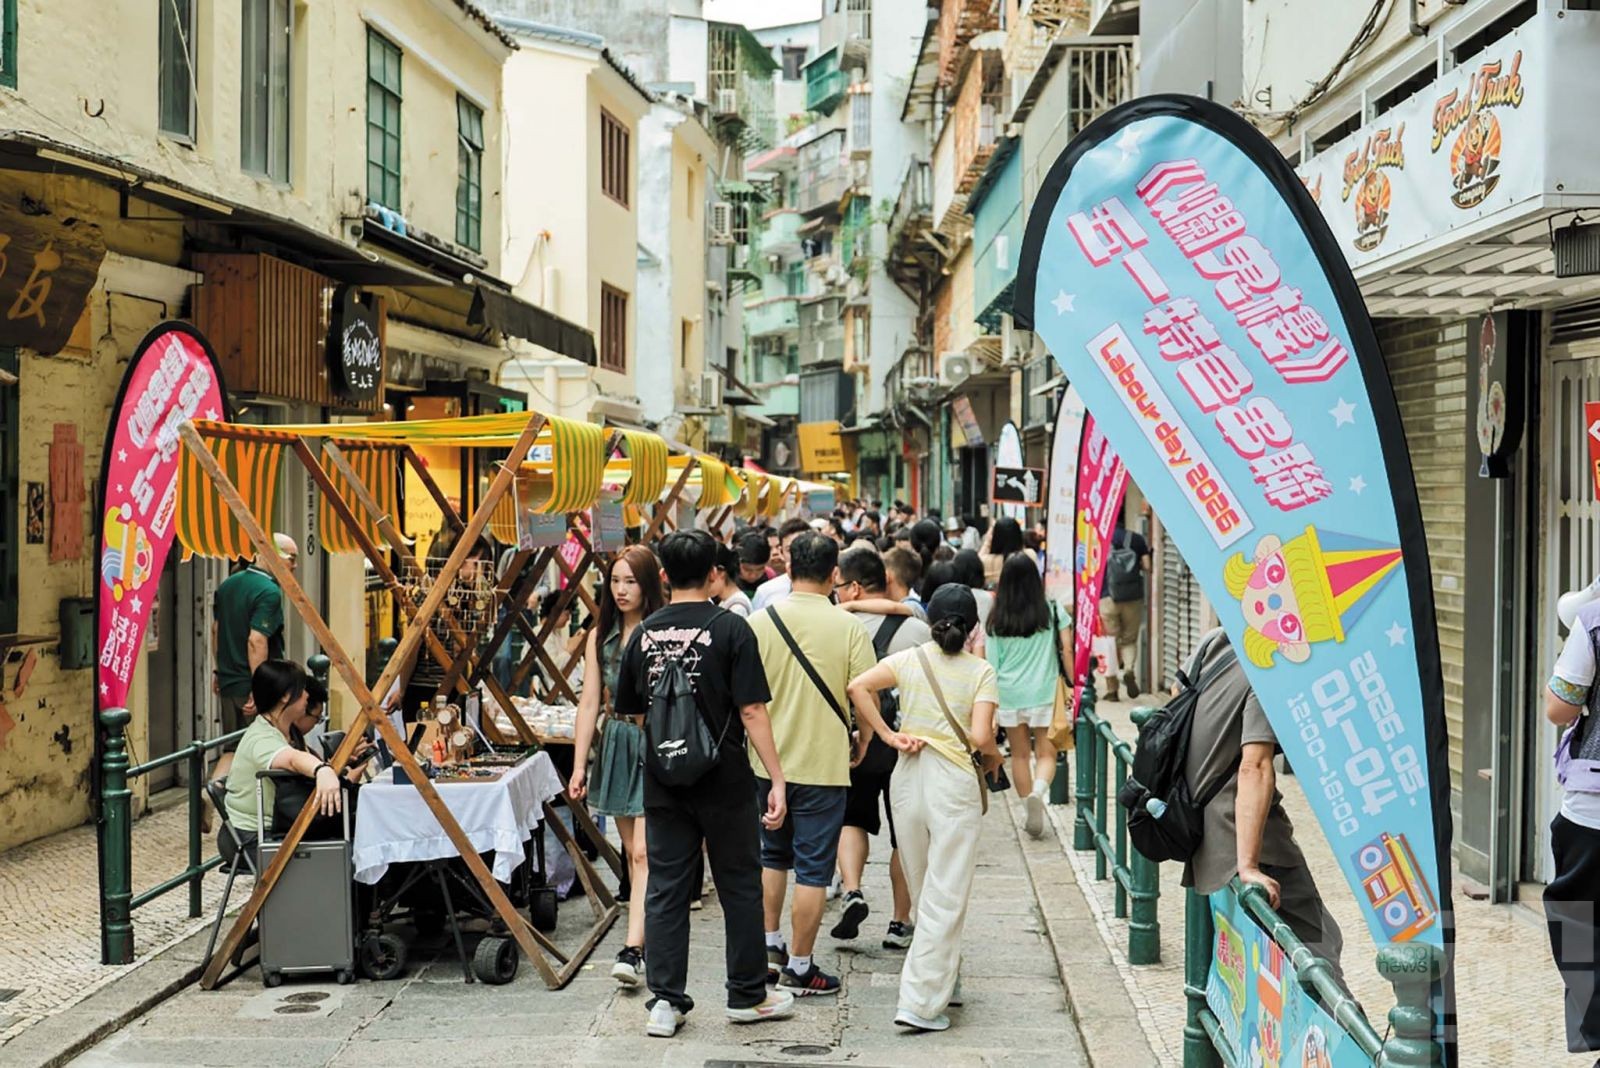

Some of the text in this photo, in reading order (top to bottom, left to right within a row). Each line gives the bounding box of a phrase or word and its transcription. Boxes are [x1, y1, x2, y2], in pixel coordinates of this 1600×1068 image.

[1431, 50, 1524, 154] Food Truck
[1066, 195, 1334, 512] 五一特色串聯
[1100, 337, 1241, 535] Labour day 2026
[1287, 692, 1360, 837] 12:00-18:00
[1311, 668, 1398, 817] 01-04
[1350, 650, 1427, 806] 2026.05.
